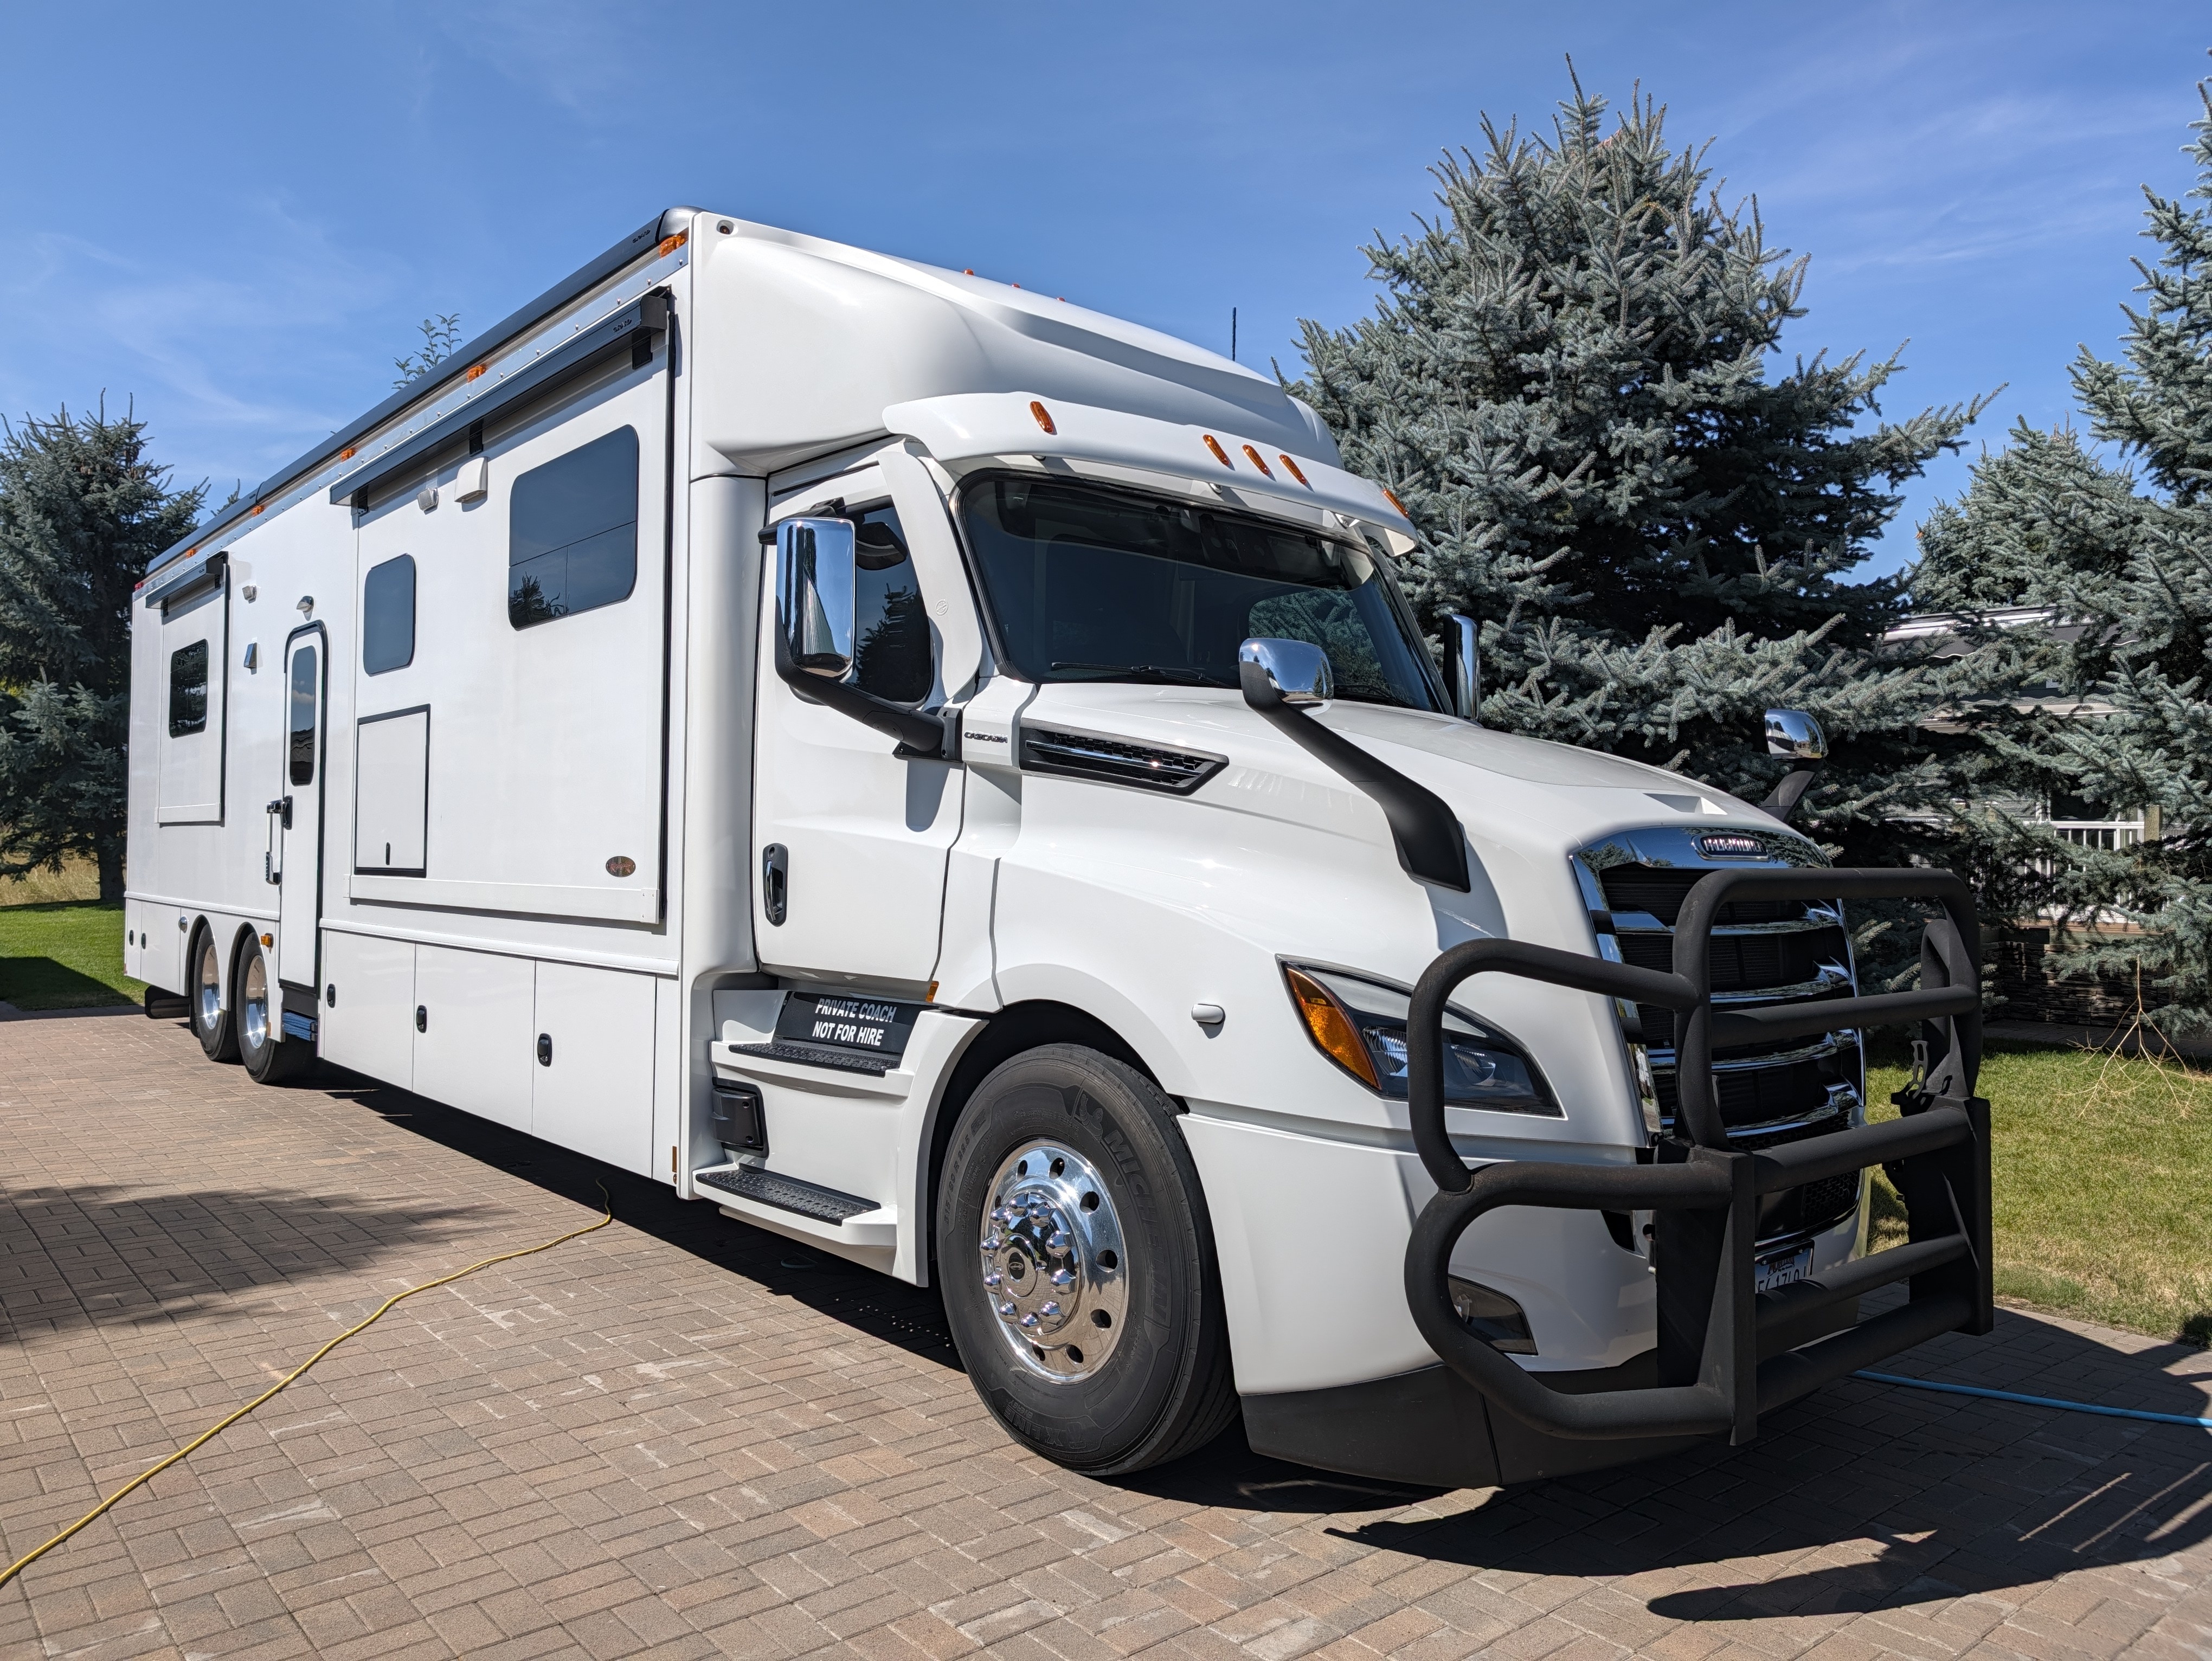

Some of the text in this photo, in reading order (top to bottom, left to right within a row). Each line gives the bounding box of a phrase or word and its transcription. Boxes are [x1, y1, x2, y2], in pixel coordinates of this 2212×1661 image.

[815, 998, 897, 1023] PRIVATE COACH
[812, 1021, 884, 1046] NOT FOR HIRE
[1104, 1129, 1168, 1322] MICHELIN
[1009, 1399, 1033, 1419] ENERGY
[1004, 1405, 1041, 1440] LINE
